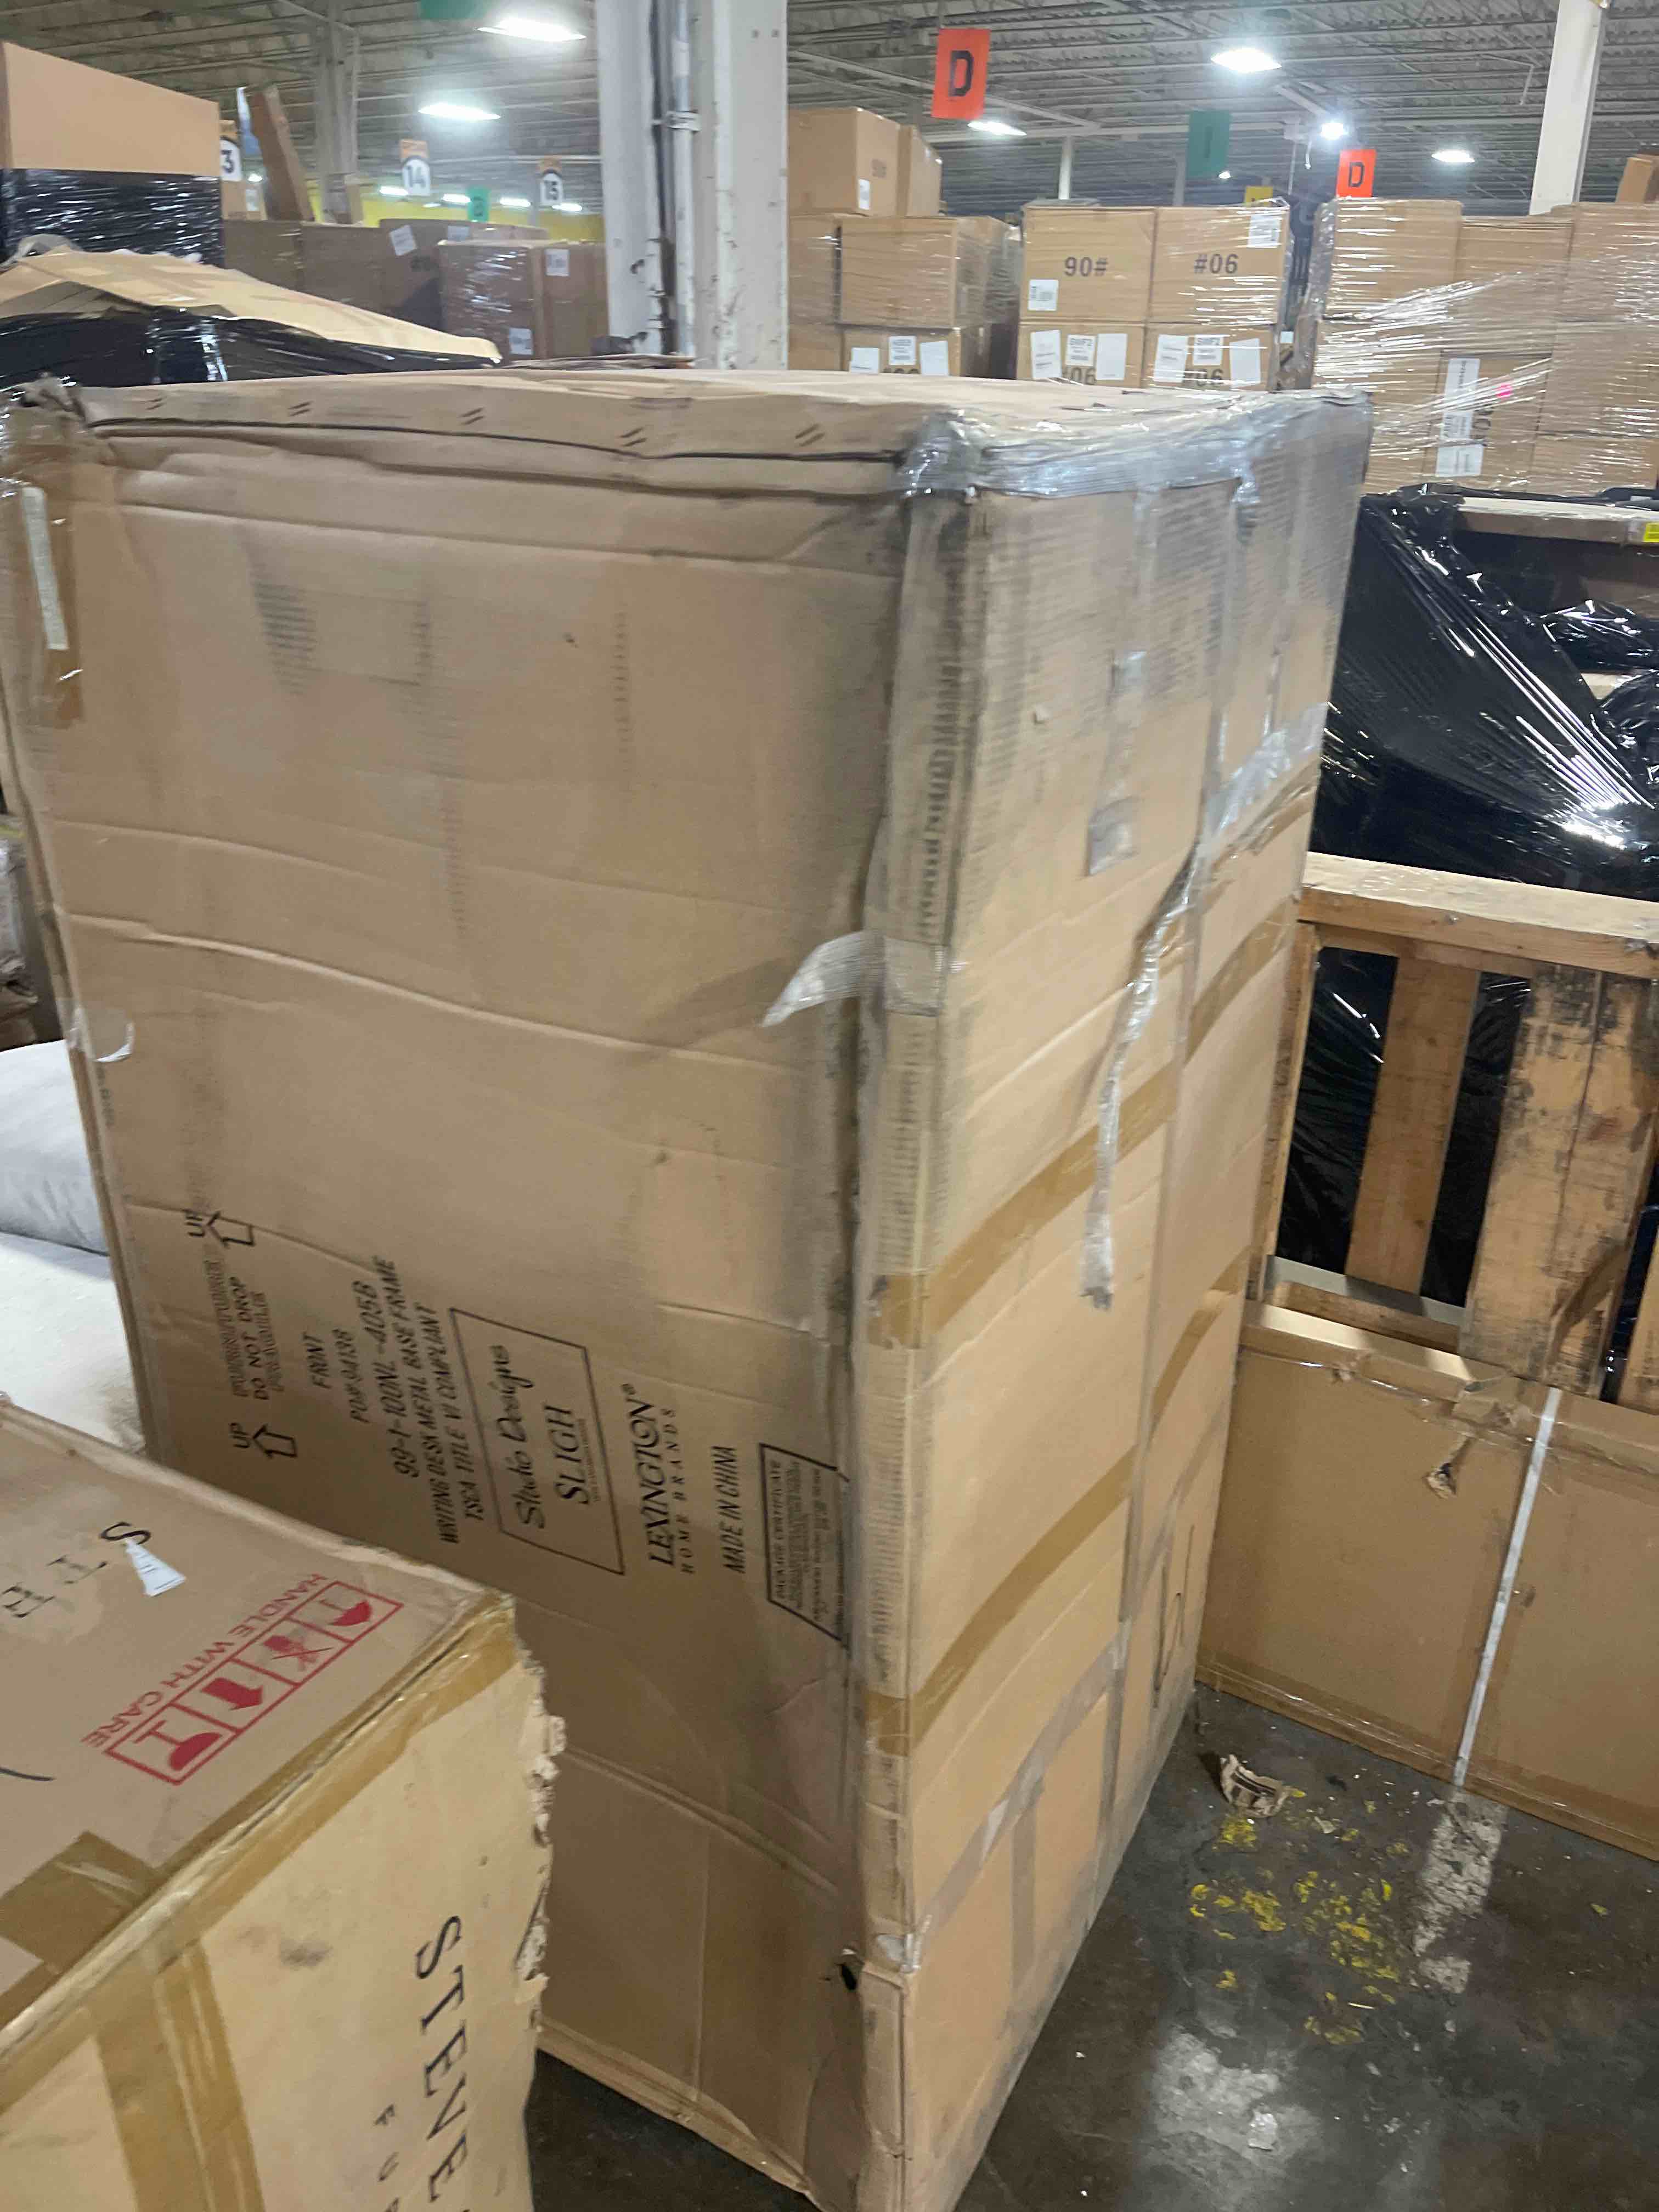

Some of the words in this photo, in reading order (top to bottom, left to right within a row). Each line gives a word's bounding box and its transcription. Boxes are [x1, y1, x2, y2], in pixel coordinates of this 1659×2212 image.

[947, 49, 975, 97] D
[1347, 161, 1365, 188] D
[1193, 253, 1239, 274] #06
[186, 1209, 206, 1238] UP
[228, 1276, 253, 1323] DROP
[373, 1256, 410, 1321] FRAME
[240, 1331, 263, 1368] NOT
[302, 1331, 331, 1389] FRONT
[392, 1322, 422, 1370] BASE
[415, 1302, 457, 1400] COMPLIANT
[253, 1376, 270, 1401] DO
[407, 1377, 437, 1430] METAL
[489, 1345, 534, 1443] Designs
[229, 1422, 252, 1448] UP
[421, 1435, 447, 1477] DESK
[444, 1426, 475, 1473] TITLE
[544, 1405, 589, 1505] SLIGH
[661, 1408, 687, 1501] BRANDS
[505, 1450, 545, 1529] Studio
[711, 1446, 740, 1498] CHINA
[429, 1477, 460, 1544] WRITING
[718, 1499, 741, 1520] IN
[675, 1514, 695, 1575] HOME
[719, 1521, 746, 1574] MADE
[227, 1573, 329, 1638] HANDLE
[160, 1640, 235, 1688] WITH
[81, 1690, 163, 1747] CARE
[415, 1915, 470, 2212] STEVE
